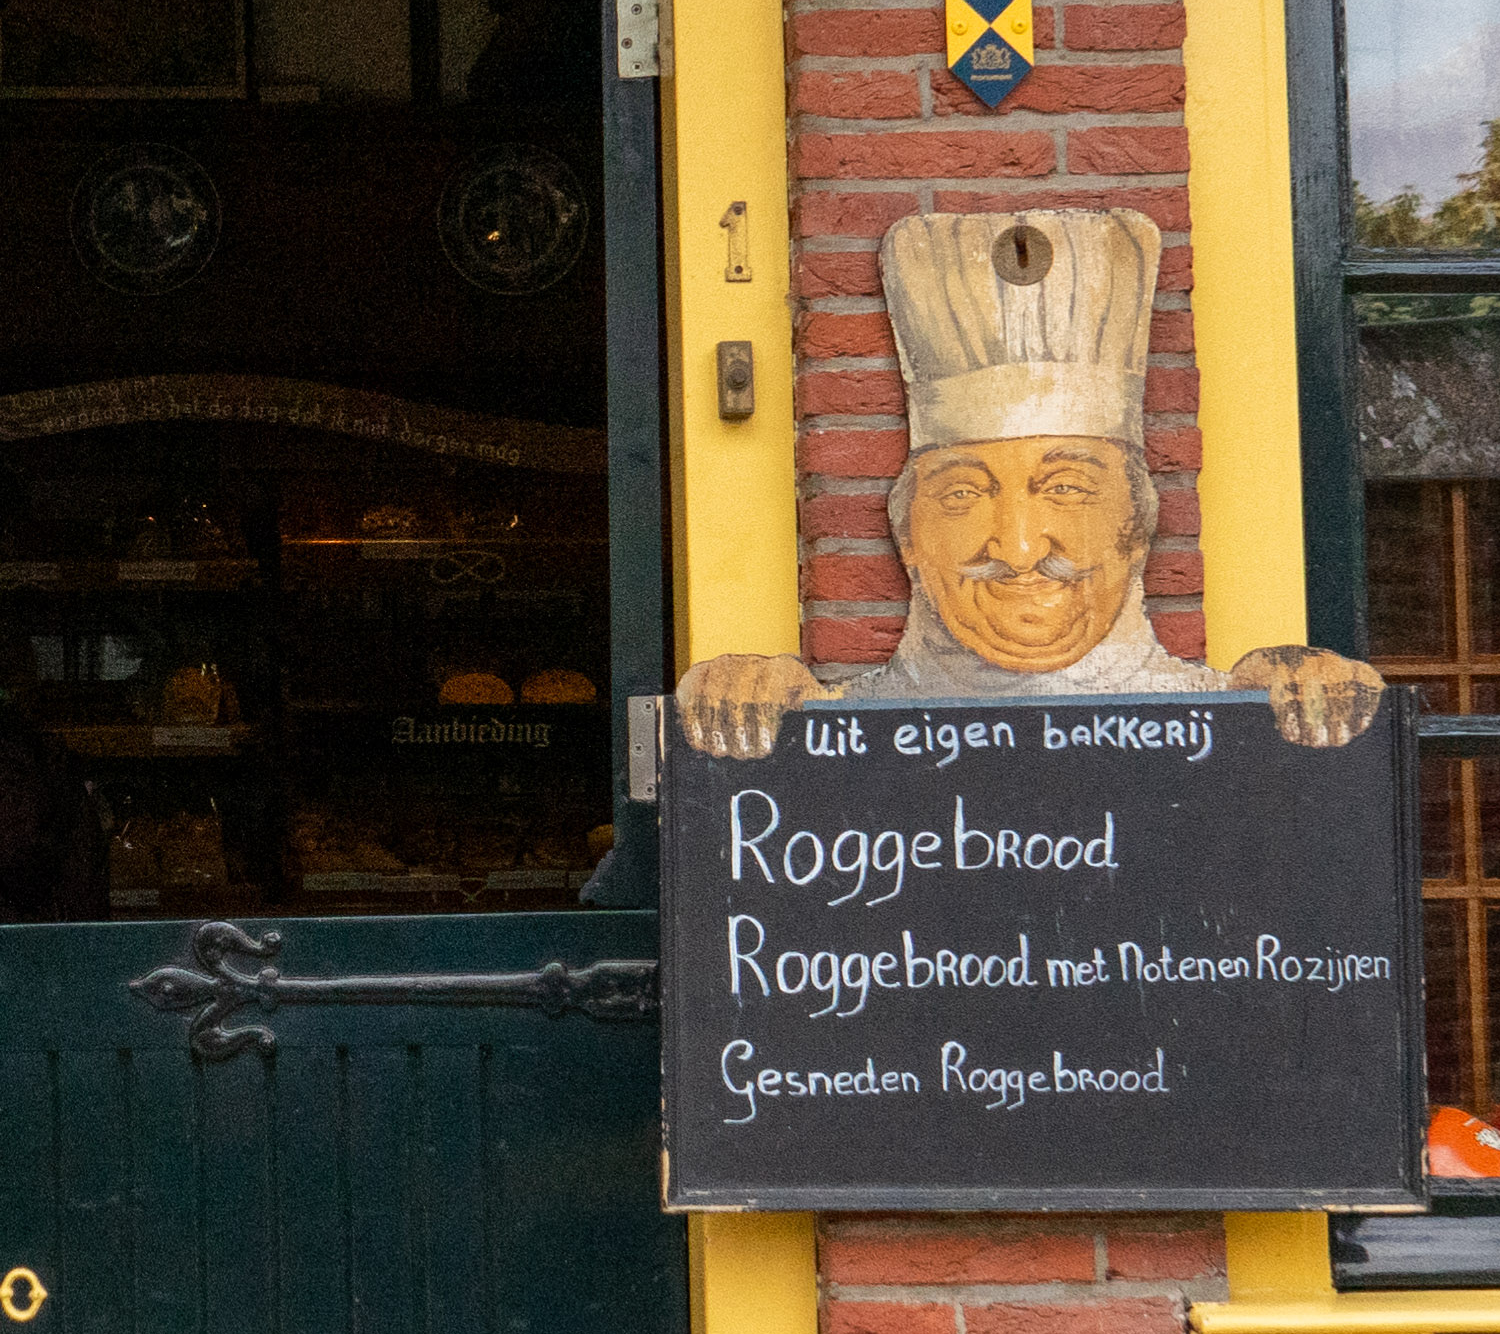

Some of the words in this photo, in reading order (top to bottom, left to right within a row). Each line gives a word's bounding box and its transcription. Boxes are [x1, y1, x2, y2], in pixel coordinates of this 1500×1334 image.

[718, 200, 752, 282] 1
[390, 715, 552, 749] Aanbieding
[893, 712, 1016, 767] eigen
[730, 788, 1119, 906] Roggebrood
[727, 913, 1038, 1019] Roggebrood
[1046, 946, 1110, 987] met
[1255, 933, 1391, 992] Rozijnen
[721, 1038, 921, 1125] Gesneden
[942, 1040, 1170, 1111] Roggebrood
